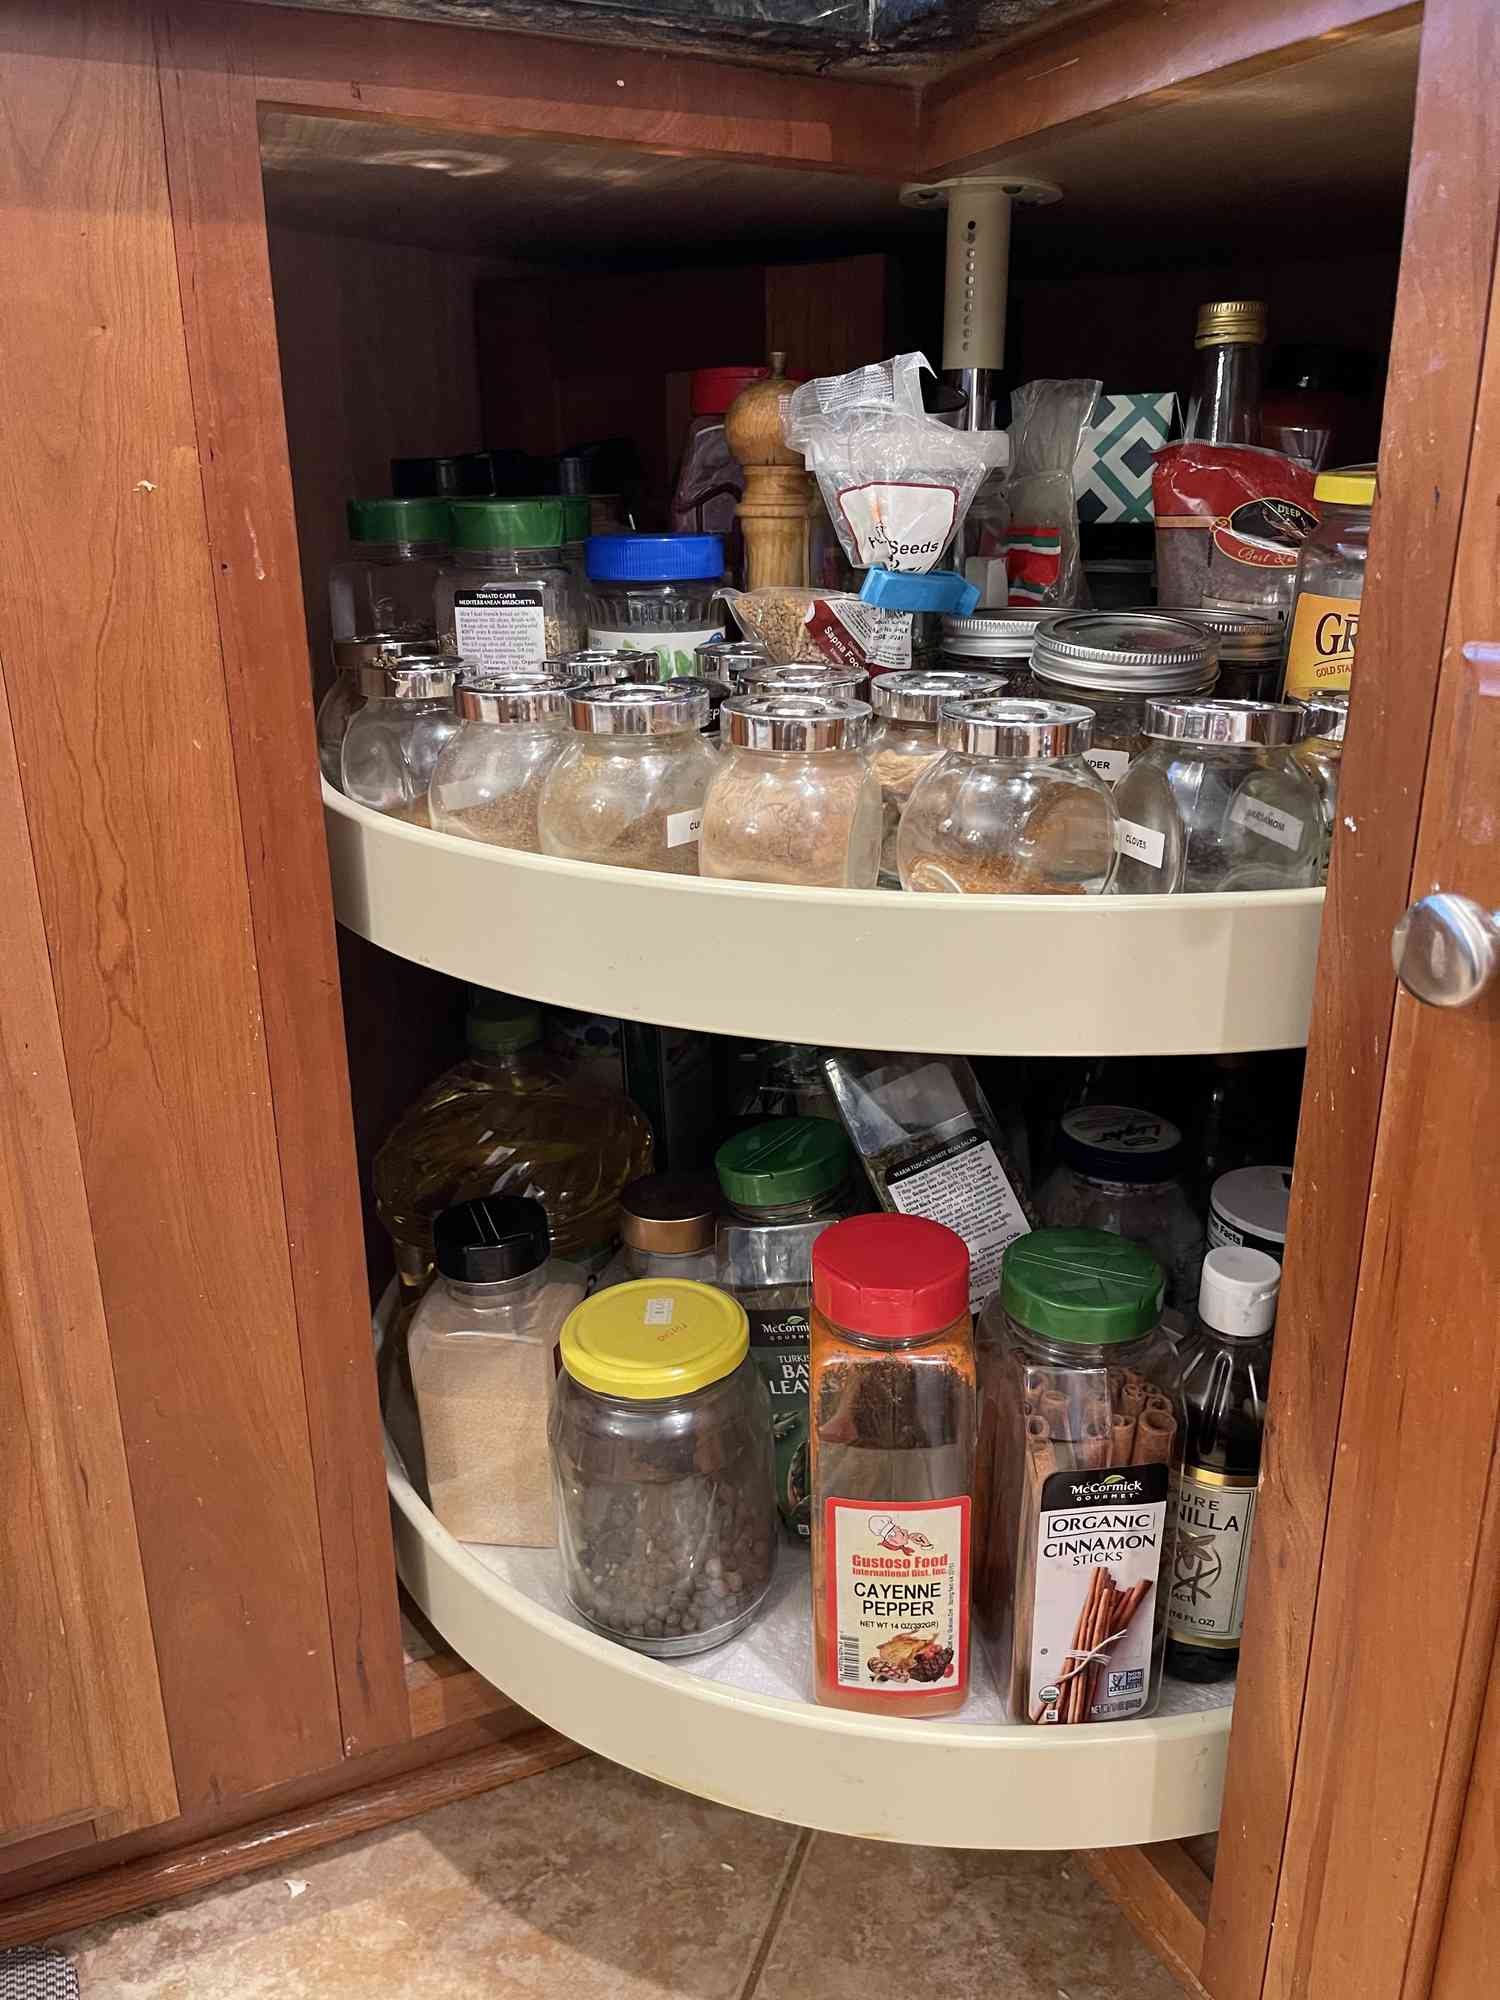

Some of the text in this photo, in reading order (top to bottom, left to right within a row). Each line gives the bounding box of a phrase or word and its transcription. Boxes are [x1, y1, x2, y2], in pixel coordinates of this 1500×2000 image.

[889, 540, 939, 556] Seeds
[824, 624, 847, 654] Sapna
[1315, 663, 1353, 678] GOLD STA
[1125, 834, 1147, 850] CLOVES
[1068, 1479, 1144, 1495] McCormick
[1075, 1493, 1135, 1502] GOURMET
[1051, 1512, 1151, 1533] ORGANIC
[1042, 1532, 1156, 1559] CINNAMON
[852, 1553, 948, 1569] Gustoso Food
[1072, 1549, 1123, 1566] STICKS
[852, 1568, 910, 1577] International
[854, 1582, 941, 1600] CAYENNE
[863, 1600, 934, 1616] PEPPER
[860, 1620, 876, 1628] NET
